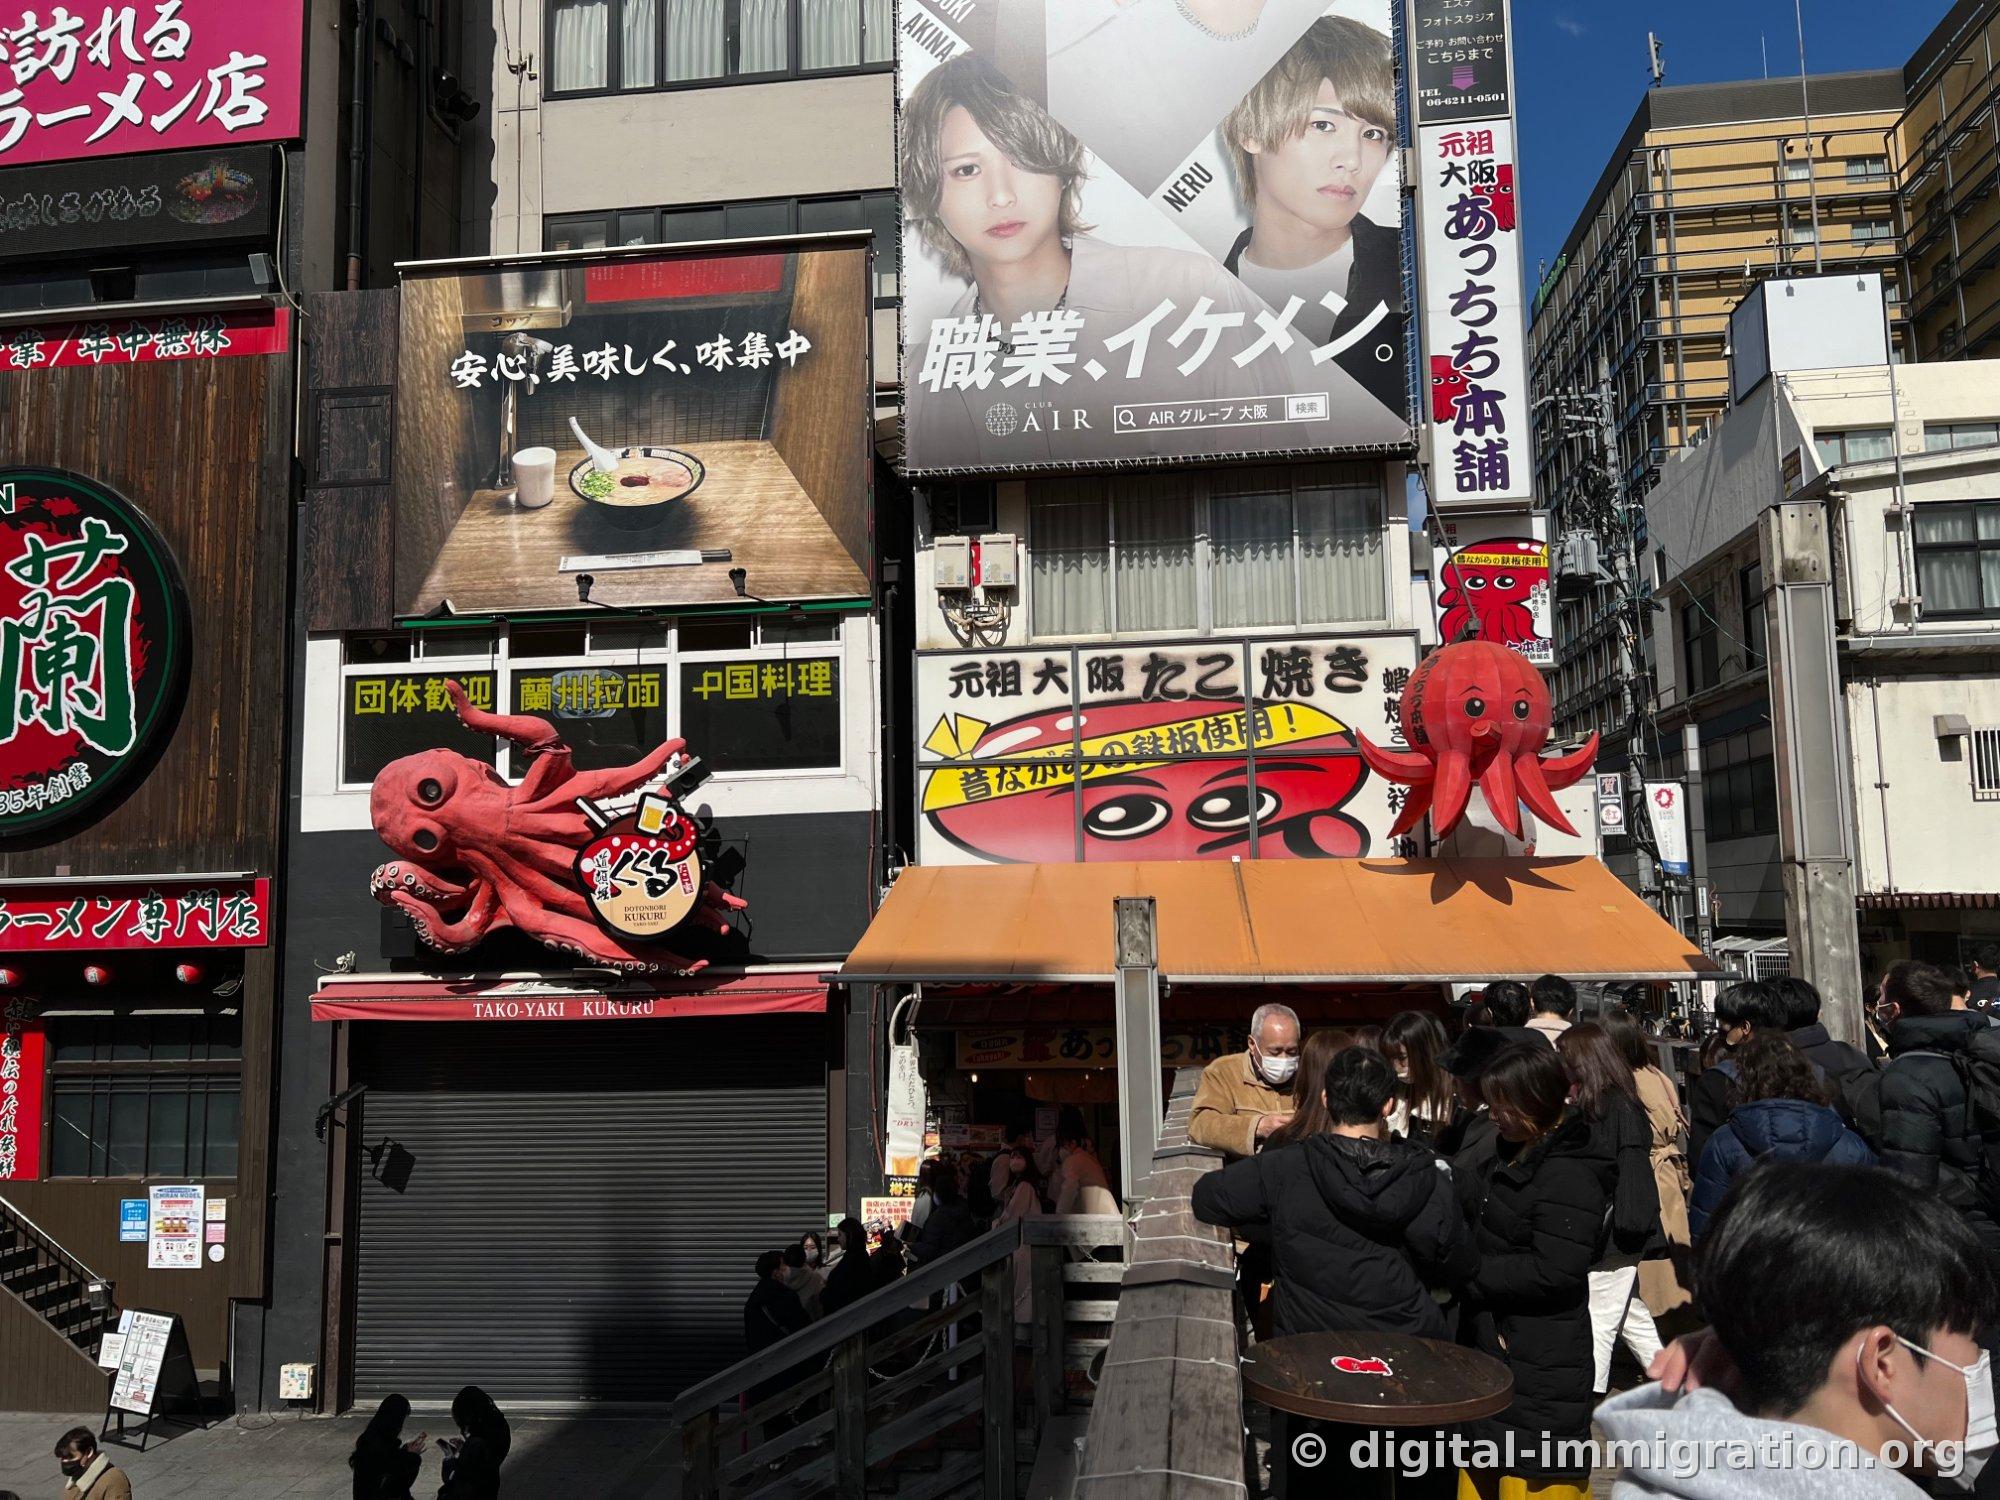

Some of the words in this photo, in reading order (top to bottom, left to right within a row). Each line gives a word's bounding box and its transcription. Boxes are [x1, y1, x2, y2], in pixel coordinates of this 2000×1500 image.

[1423, 12, 1495, 27] フォトスタジオ
[902, 12, 956, 63] AKINA
[1427, 48, 1494, 64] こちらまで
[0, 51, 268, 150] ラーメン店
[1419, 89, 1441, 97] TEL
[1426, 93, 1505, 107] 06-6211-0501
[1438, 130, 1494, 158] 元祖
[1162, 161, 1213, 212] NERU
[1440, 160, 1497, 187] 大阪
[919, 290, 1393, 392] 職業、イケメン。
[1444, 194, 1511, 493] あっちち本舗
[450, 329, 811, 388] 安心、美味しく、味集中
[1025, 401, 1054, 409] CLUB
[1149, 411, 1175, 425] AIR
[1179, 405, 1235, 422] グループ
[1238, 404, 1269, 420] 大阪
[1296, 402, 1319, 414] 検索
[1021, 408, 1093, 433] AIR
[692, 661, 833, 701] 中国料理
[948, 644, 1370, 702] 元祖大阪たこ焼き
[355, 675, 492, 715] 団体歓迎
[624, 905, 667, 913] DOTONBORI
[624, 912, 668, 921] KUKURU
[473, 1002, 565, 1018] TAKO-YAKI
[582, 1000, 654, 1016] KUKURU
